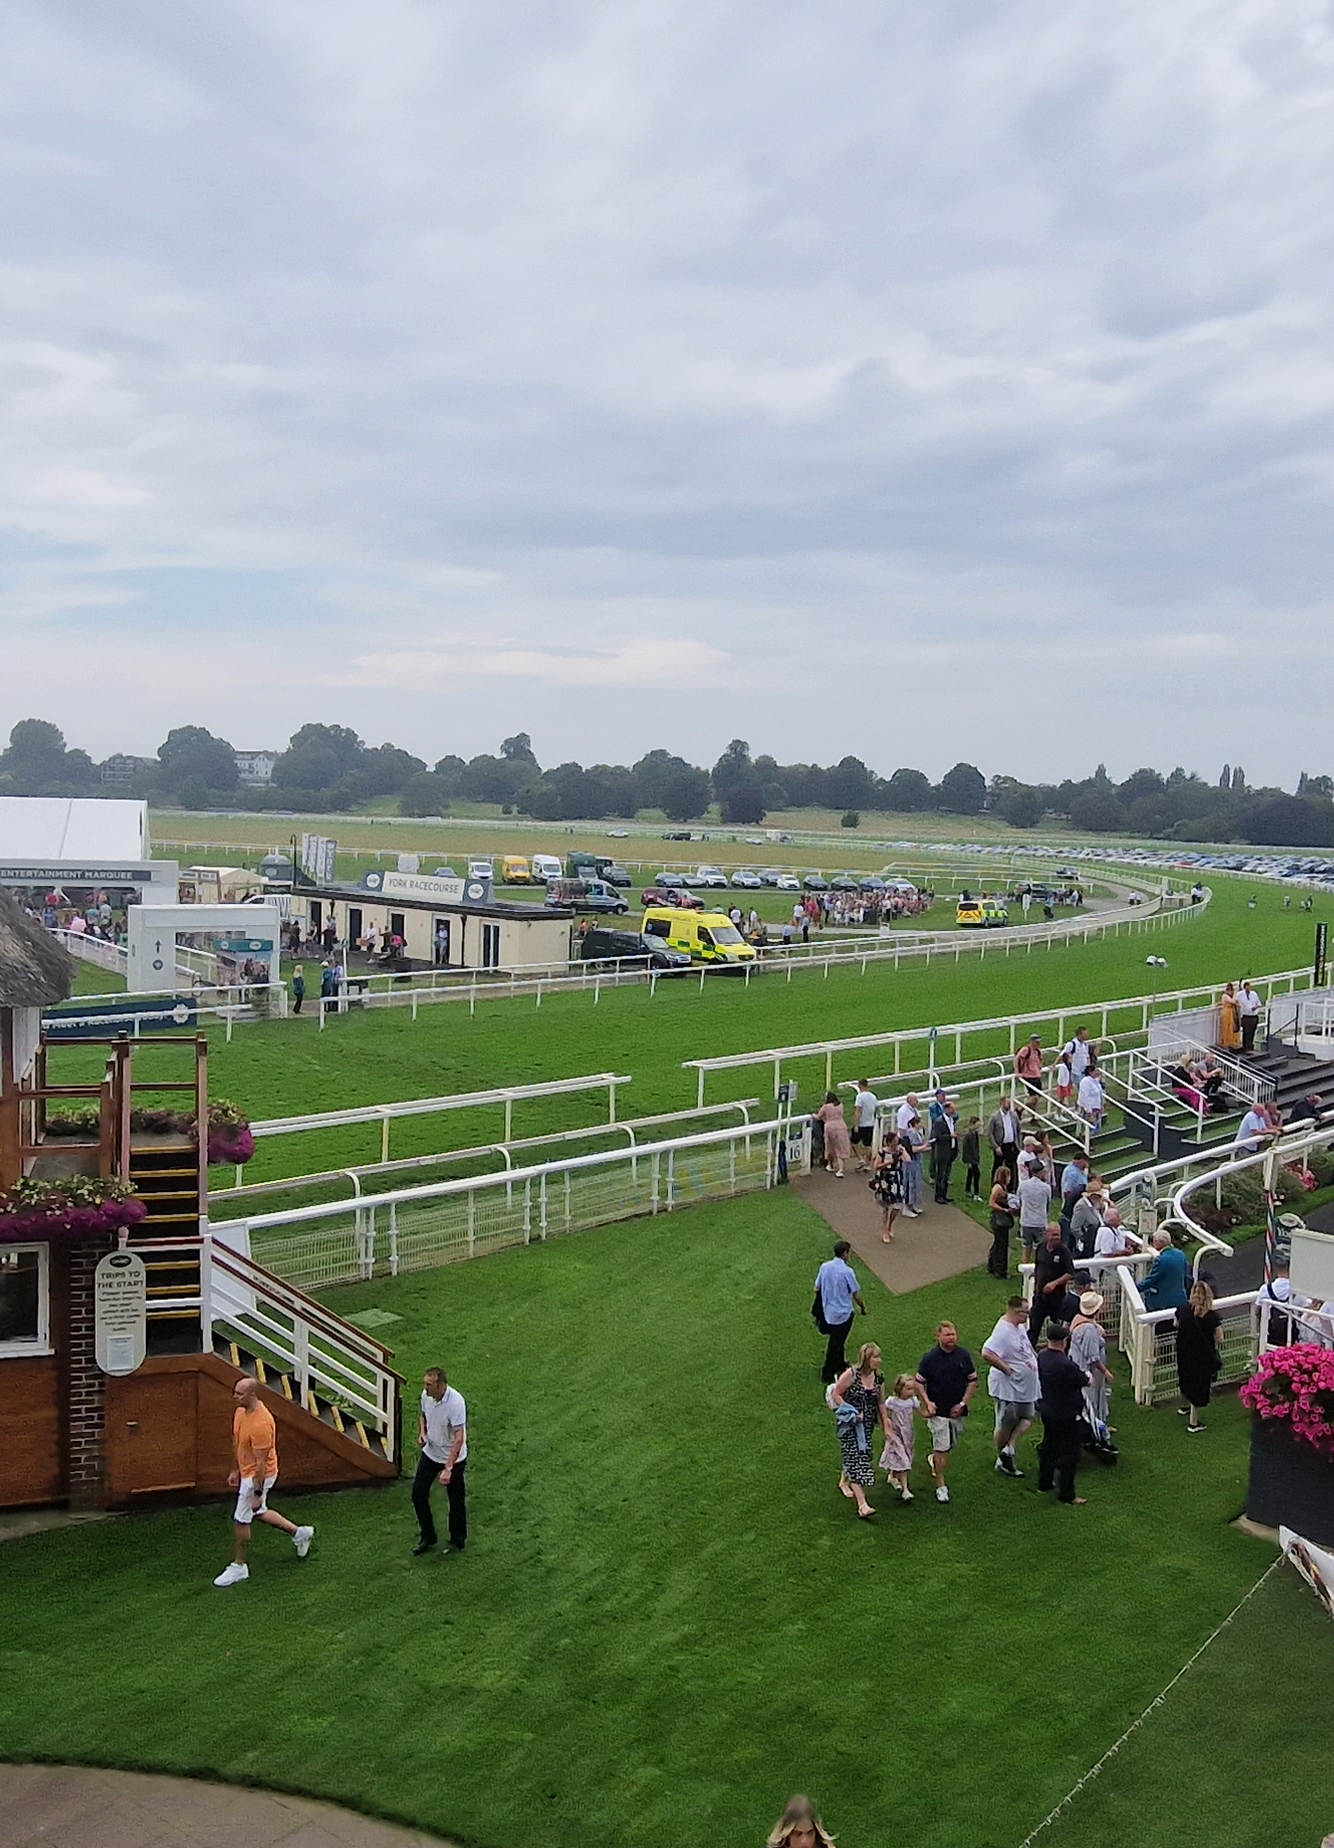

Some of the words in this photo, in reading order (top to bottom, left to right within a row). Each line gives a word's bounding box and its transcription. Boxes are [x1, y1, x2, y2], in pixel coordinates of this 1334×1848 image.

[0, 869, 83, 880] ENTERTAINMENT
[85, 870, 133, 881] MARQUEE
[388, 878, 408, 889] YORK
[409, 879, 459, 895] RACECOURSE
[789, 1144, 801, 1160] 16
[101, 1272, 126, 1280] TRIPS
[129, 1270, 141, 1278] TO
[97, 1281, 114, 1289] THE
[116, 1280, 144, 1288] START
